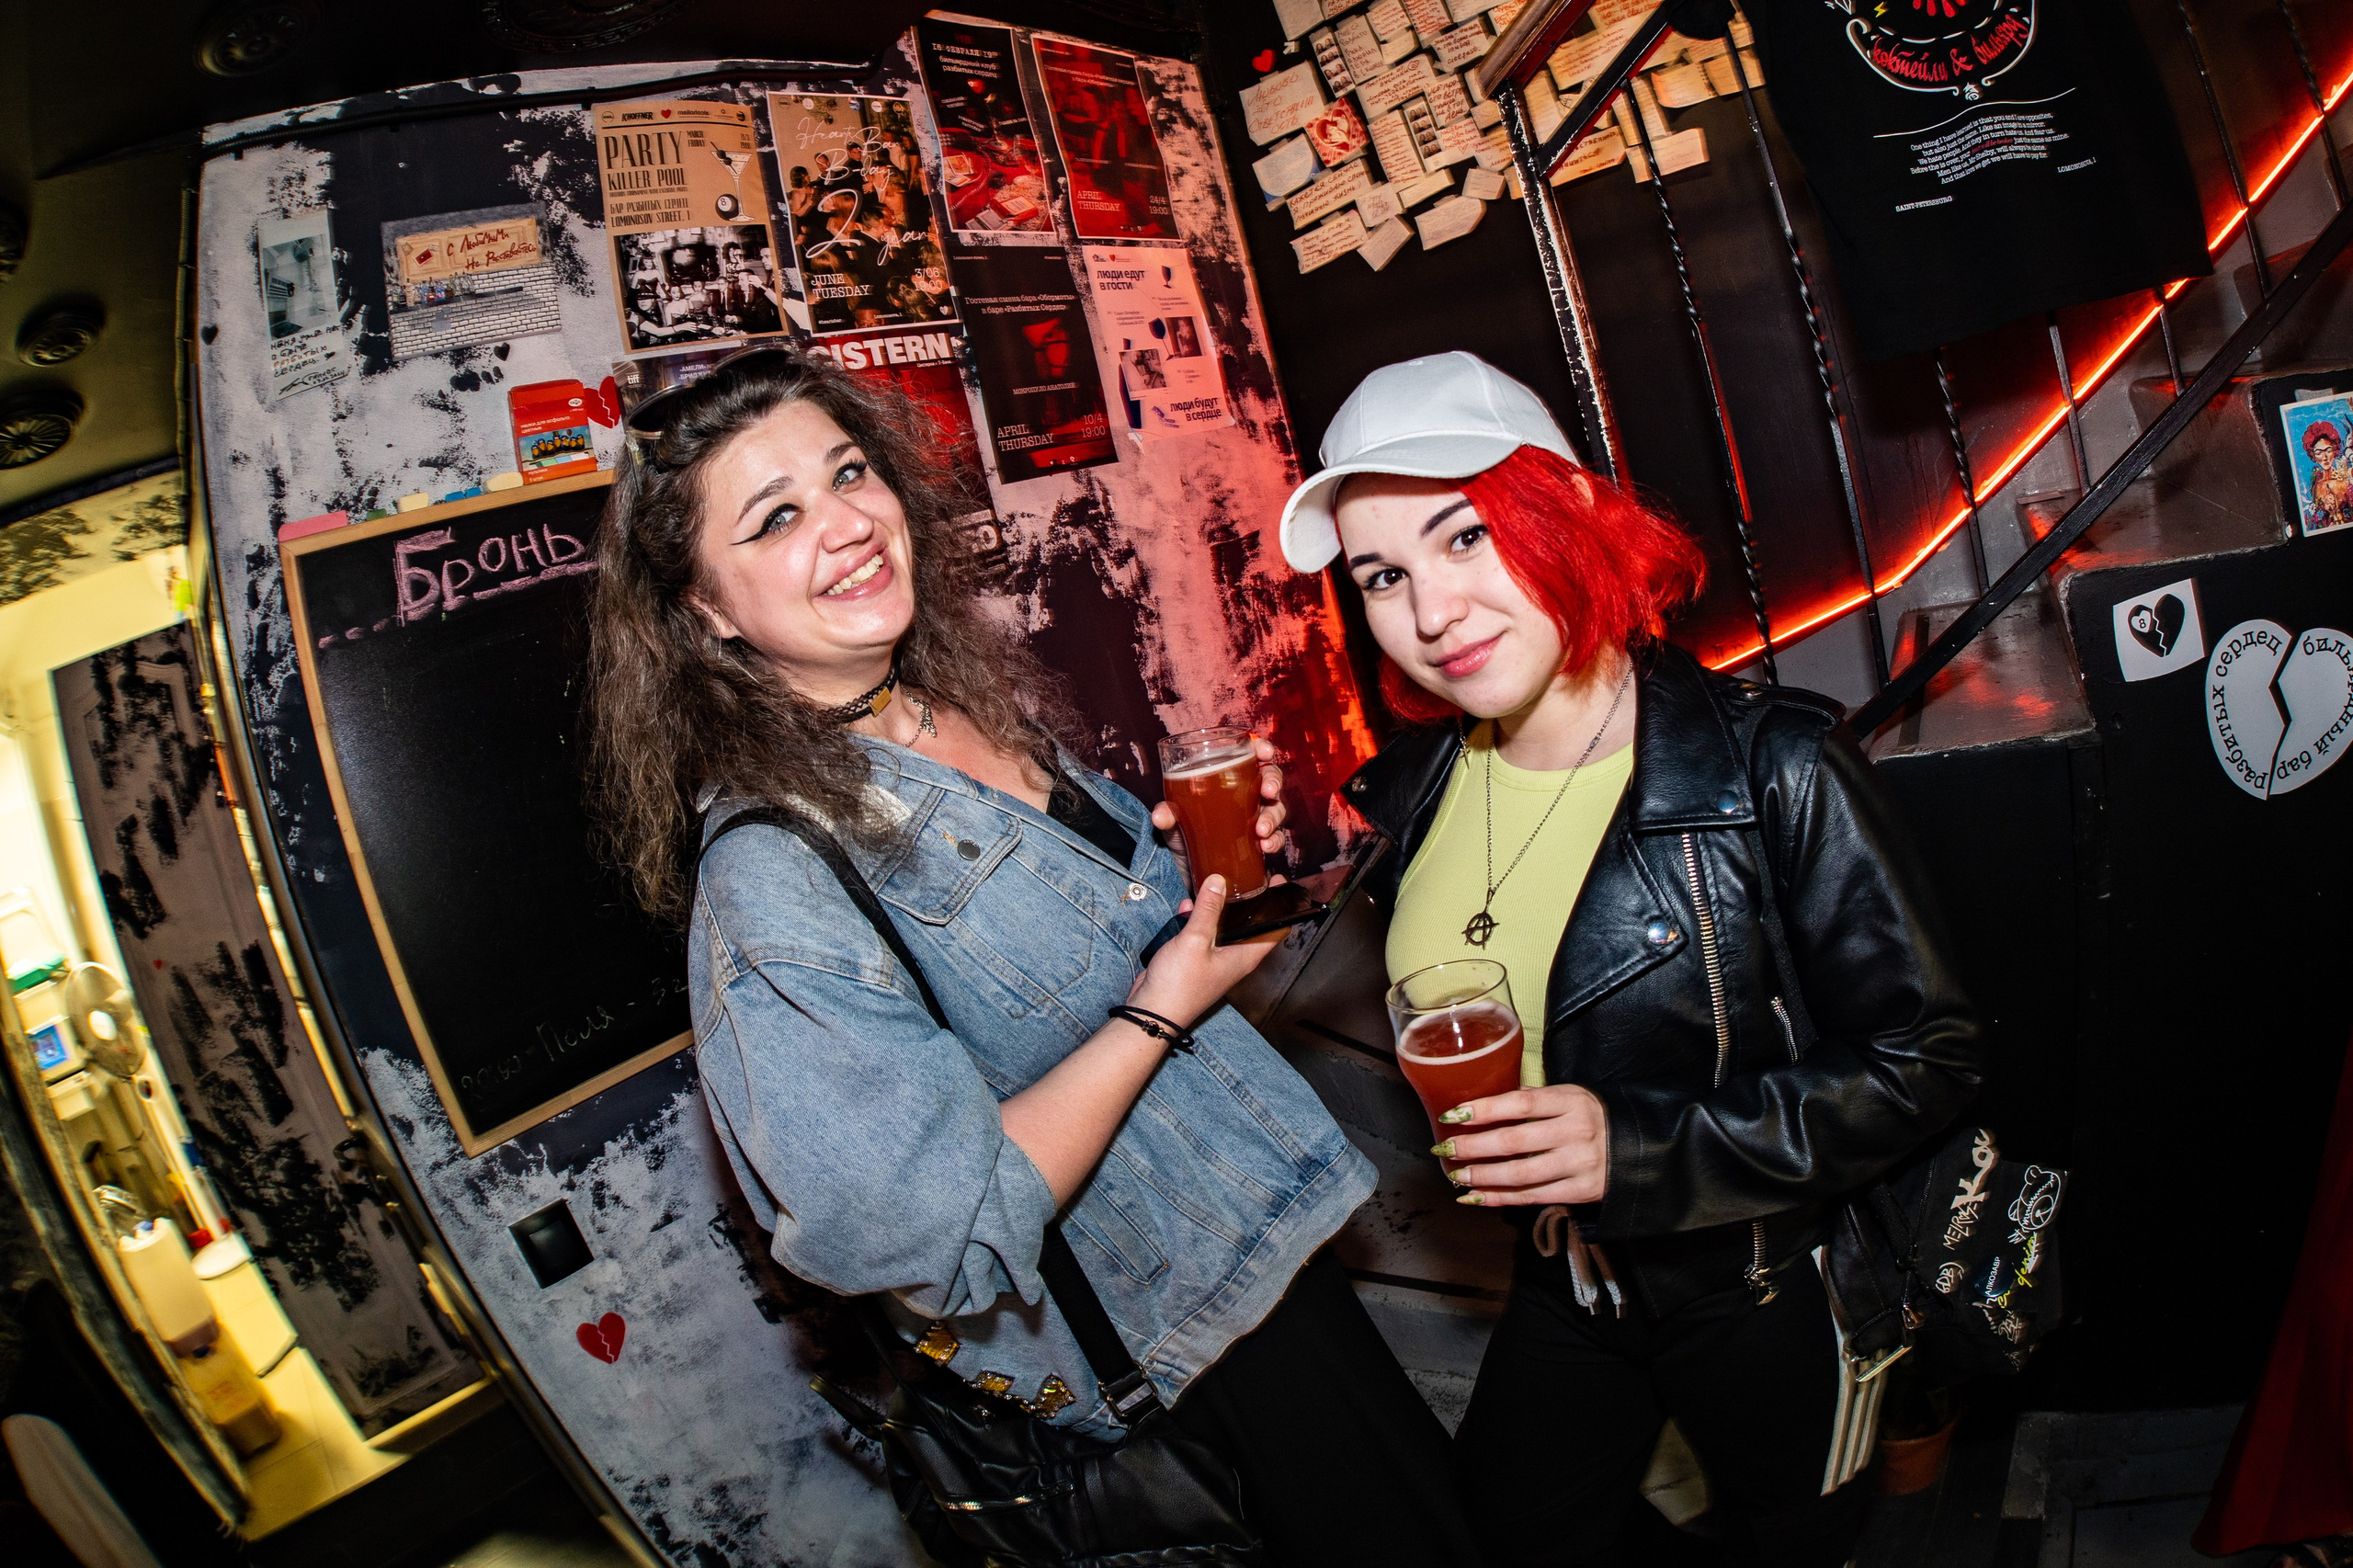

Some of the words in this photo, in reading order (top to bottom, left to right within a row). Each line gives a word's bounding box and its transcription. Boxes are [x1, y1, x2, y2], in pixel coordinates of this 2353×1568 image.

[945, 45, 980, 56] ФЕВРАЛЯ
[1872, 37, 1949, 82] коктейли
[1970, 14, 2029, 64] бильярд
[939, 55, 980, 68] бильярдный
[981, 62, 996, 71] клуб
[942, 65, 974, 74] разбитых
[974, 70, 998, 79] сердец
[687, 131, 704, 139] MARCH
[1942, 132, 1957, 142] have
[1978, 116, 1994, 125] that
[1993, 115, 2005, 123] you
[688, 139, 706, 147] FRIDAY
[1934, 145, 1947, 153] also
[1946, 141, 1958, 151] just
[1978, 124, 1994, 133] Like
[603, 131, 683, 169] PARTY
[1927, 154, 1943, 164] hate
[1961, 141, 1972, 152] And
[1970, 136, 1983, 146] they
[1990, 130, 2006, 138] turn
[815, 148, 893, 191] B-day
[1910, 166, 1928, 175] Before
[1960, 151, 1971, 163] your
[1937, 168, 1951, 177] Men
[1950, 165, 1962, 173] like
[1940, 176, 1955, 185] And
[1953, 171, 1966, 180] that
[607, 170, 651, 191] KILLER
[656, 167, 688, 187] POOL
[1076, 190, 1101, 199] APRIL
[1149, 195, 1166, 205] 24/4
[610, 203, 624, 214] БАР
[627, 199, 662, 213] РАЗБИТЫХ
[1077, 201, 1120, 211] THURSDAY
[1149, 206, 1168, 215] 19:00
[1894, 196, 1953, 212] SAINT-PETERSBURG
[610, 213, 654, 228] LOMONOSOV
[805, 188, 861, 259] 2
[811, 273, 845, 286] JUNE
[915, 267, 940, 279] 3/06
[1124, 270, 1145, 281] едут
[813, 285, 870, 300] TUESDAY
[915, 280, 943, 291] 19:00
[1107, 281, 1134, 290] гости
[1021, 294, 1038, 302] бара
[987, 306, 1004, 314] баре
[627, 373, 640, 384] tiff
[1047, 382, 1075, 391] АНАТОЛИЙ
[1195, 397, 1219, 410] будут
[1084, 414, 1103, 425] 10/4
[1192, 408, 1222, 422] сердце
[997, 424, 1029, 438] APRIL
[1082, 426, 1106, 437] 19:00
[998, 433, 1054, 451] THURSDAY
[393, 524, 585, 627] Бронь
[2139, 618, 2147, 629] 8
[2215, 631, 2282, 677] сердец
[2212, 684, 2269, 789] разбитых
[2276, 750, 2313, 779] бар
[1984, 1256, 2001, 1296] АЛКОЗАВР
